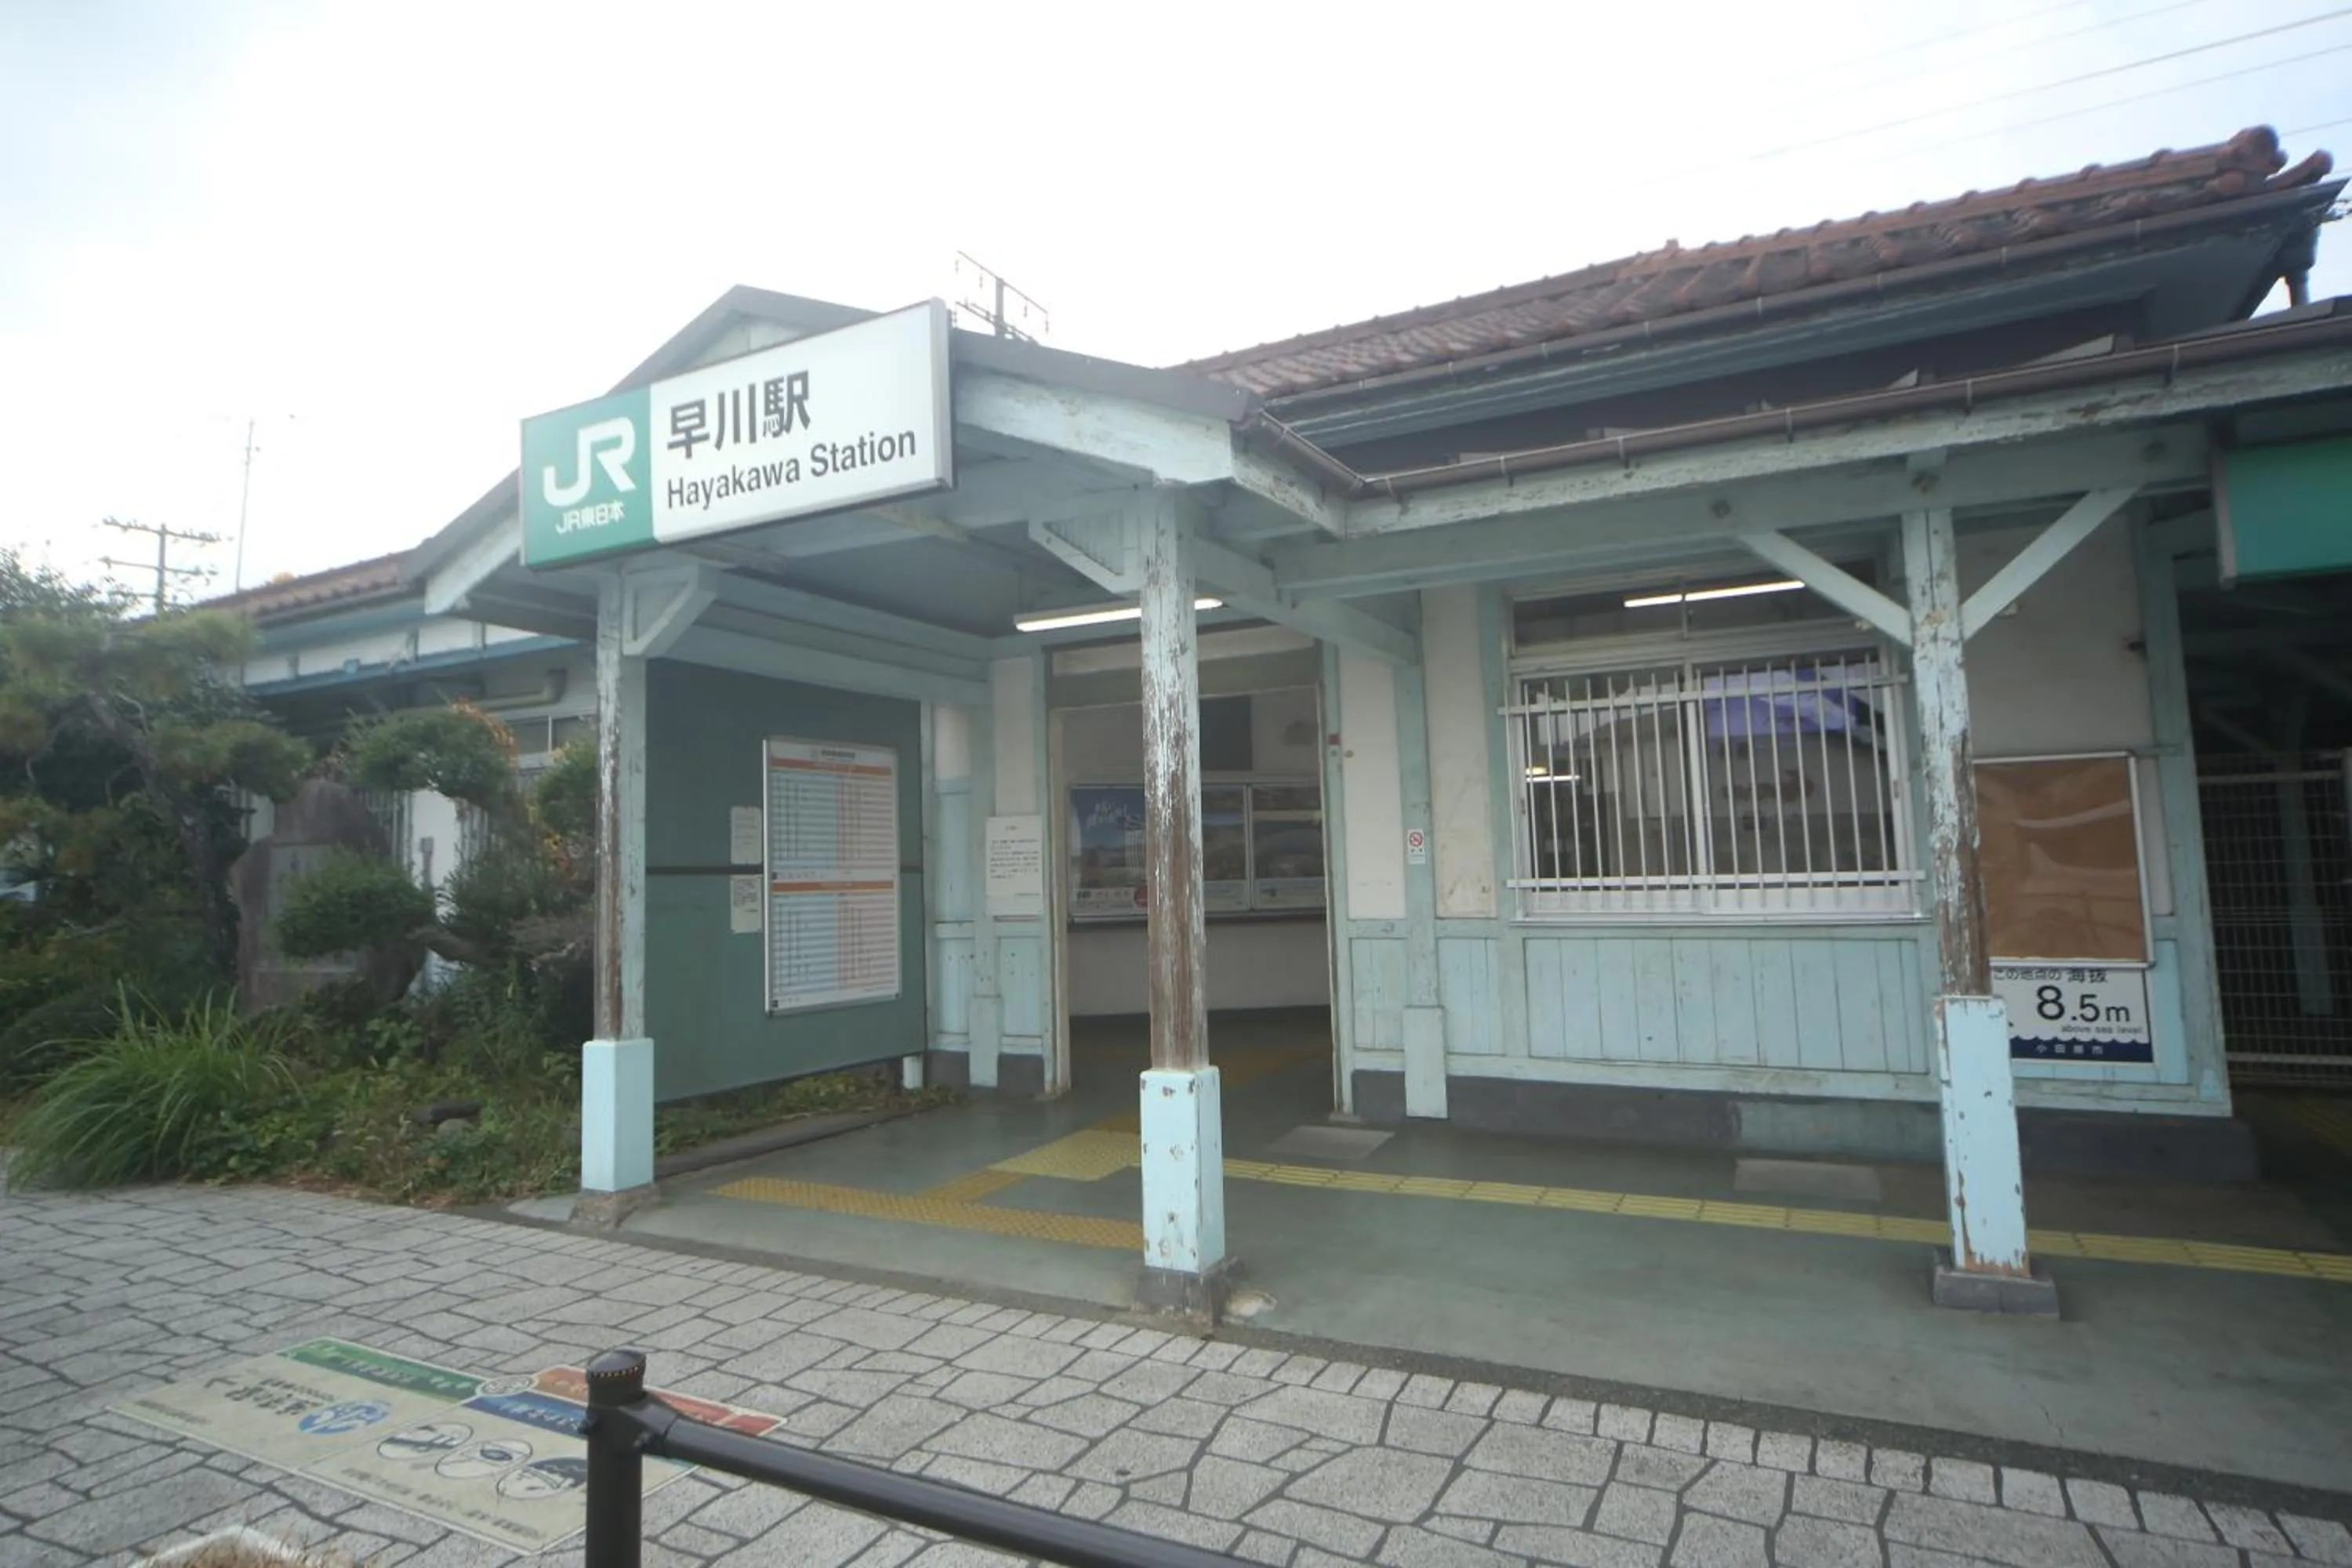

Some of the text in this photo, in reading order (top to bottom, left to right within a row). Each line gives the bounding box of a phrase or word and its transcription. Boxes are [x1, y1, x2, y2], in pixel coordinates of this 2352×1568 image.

[666, 369, 811, 460] 早川駅
[543, 416, 637, 506] JR
[667, 429, 916, 510] Hayakawa Station
[554, 499, 626, 535] JR東日本
[2036, 985, 2130, 1022] 8.5m
